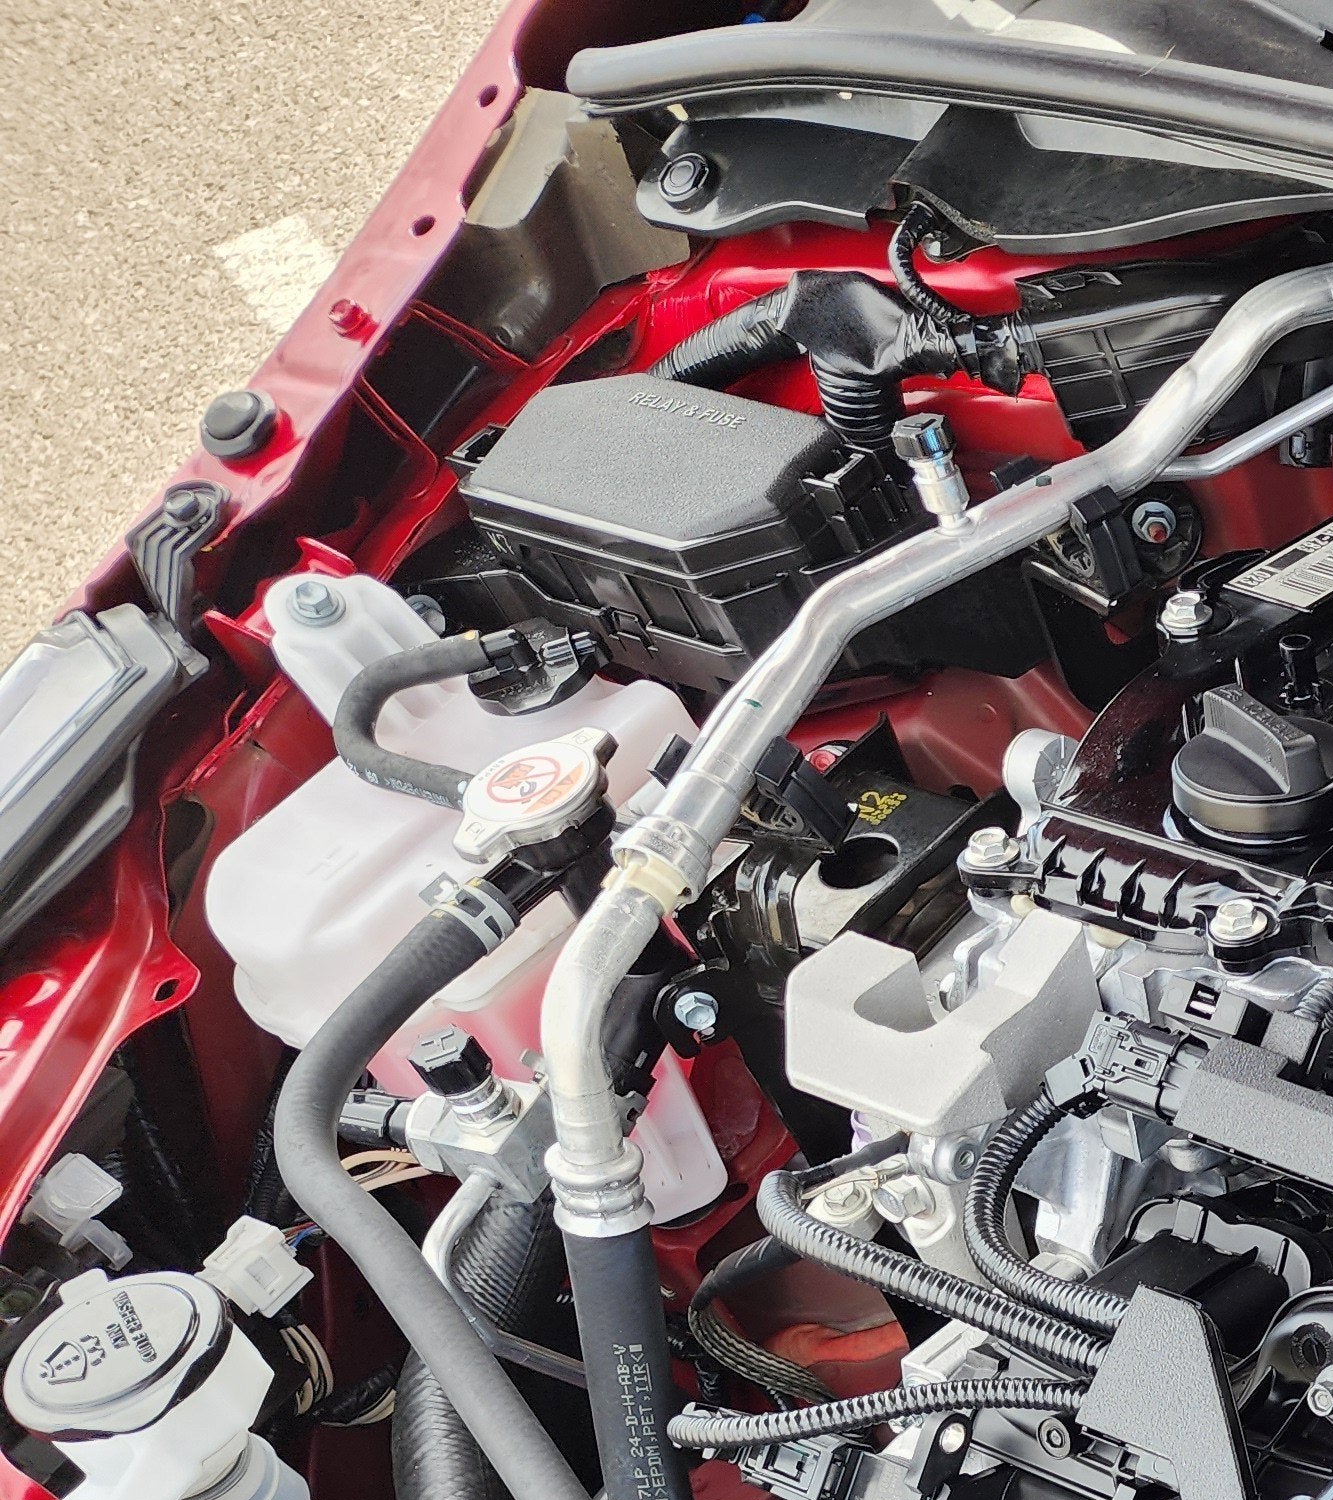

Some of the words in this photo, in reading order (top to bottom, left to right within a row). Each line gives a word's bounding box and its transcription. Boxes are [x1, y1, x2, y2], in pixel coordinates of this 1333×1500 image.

[629, 391, 686, 414] RELAY
[683, 404, 699, 418] &
[699, 408, 747, 429] FUSE
[105, 1322, 130, 1350] ONLY
[112, 1291, 143, 1334] WASHER
[132, 1328, 158, 1363] FLUID
